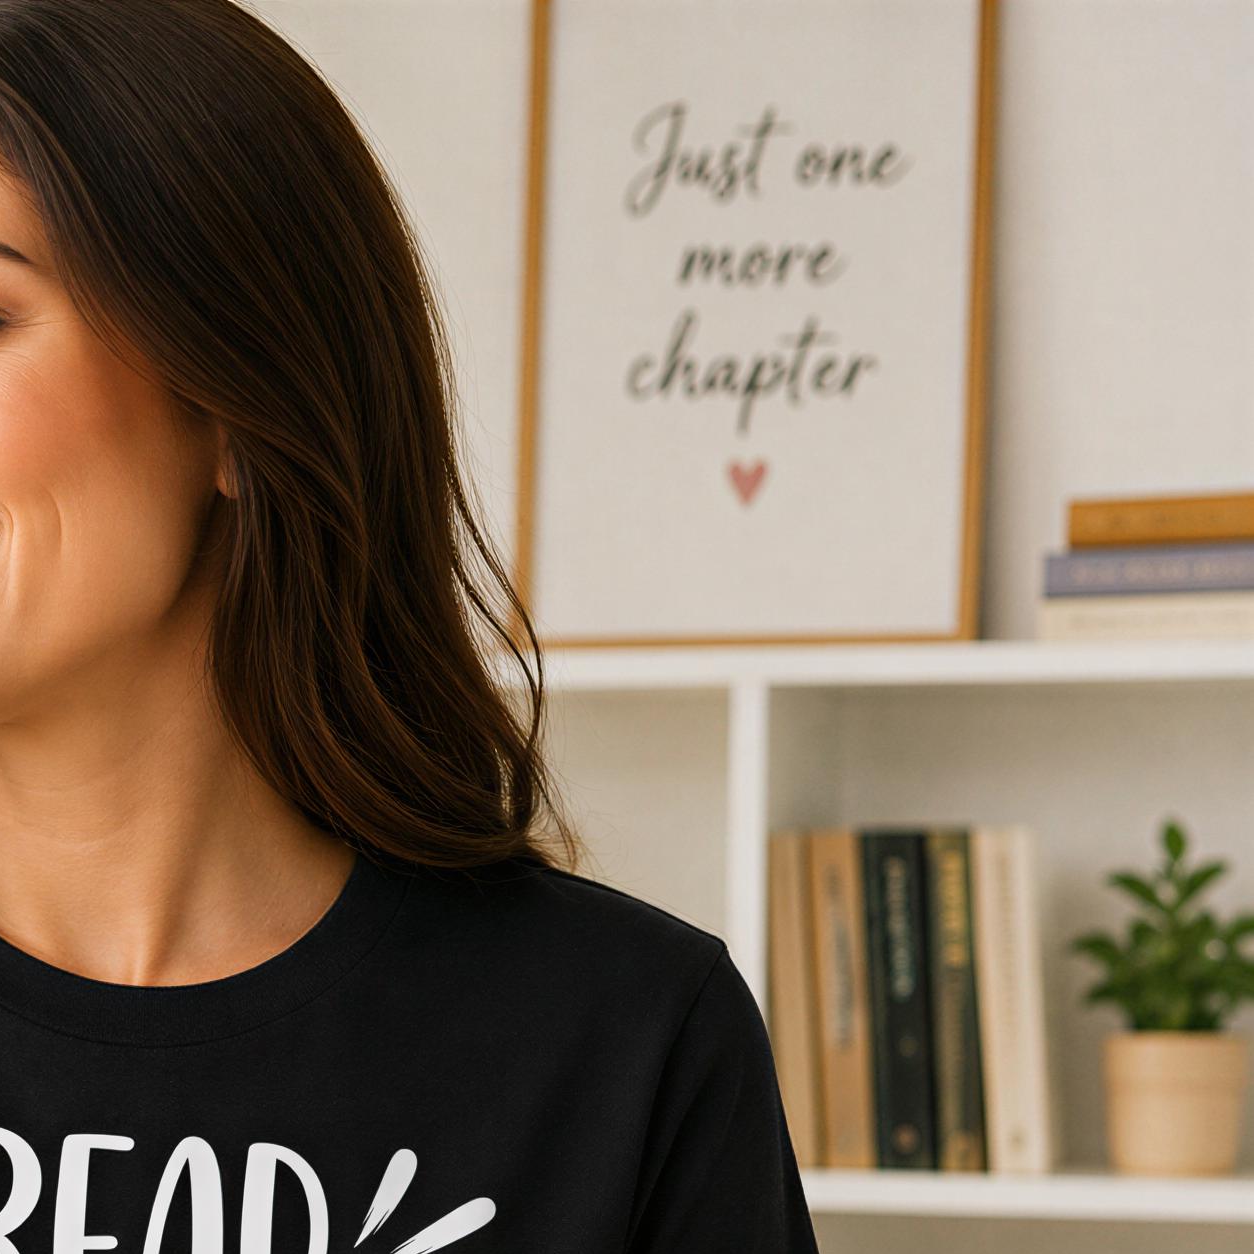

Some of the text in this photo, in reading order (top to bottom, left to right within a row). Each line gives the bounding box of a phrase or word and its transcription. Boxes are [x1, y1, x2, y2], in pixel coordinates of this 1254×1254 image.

[625, 101, 910, 217] Just one
[677, 243, 846, 288] more
[625, 310, 878, 434] chapter
